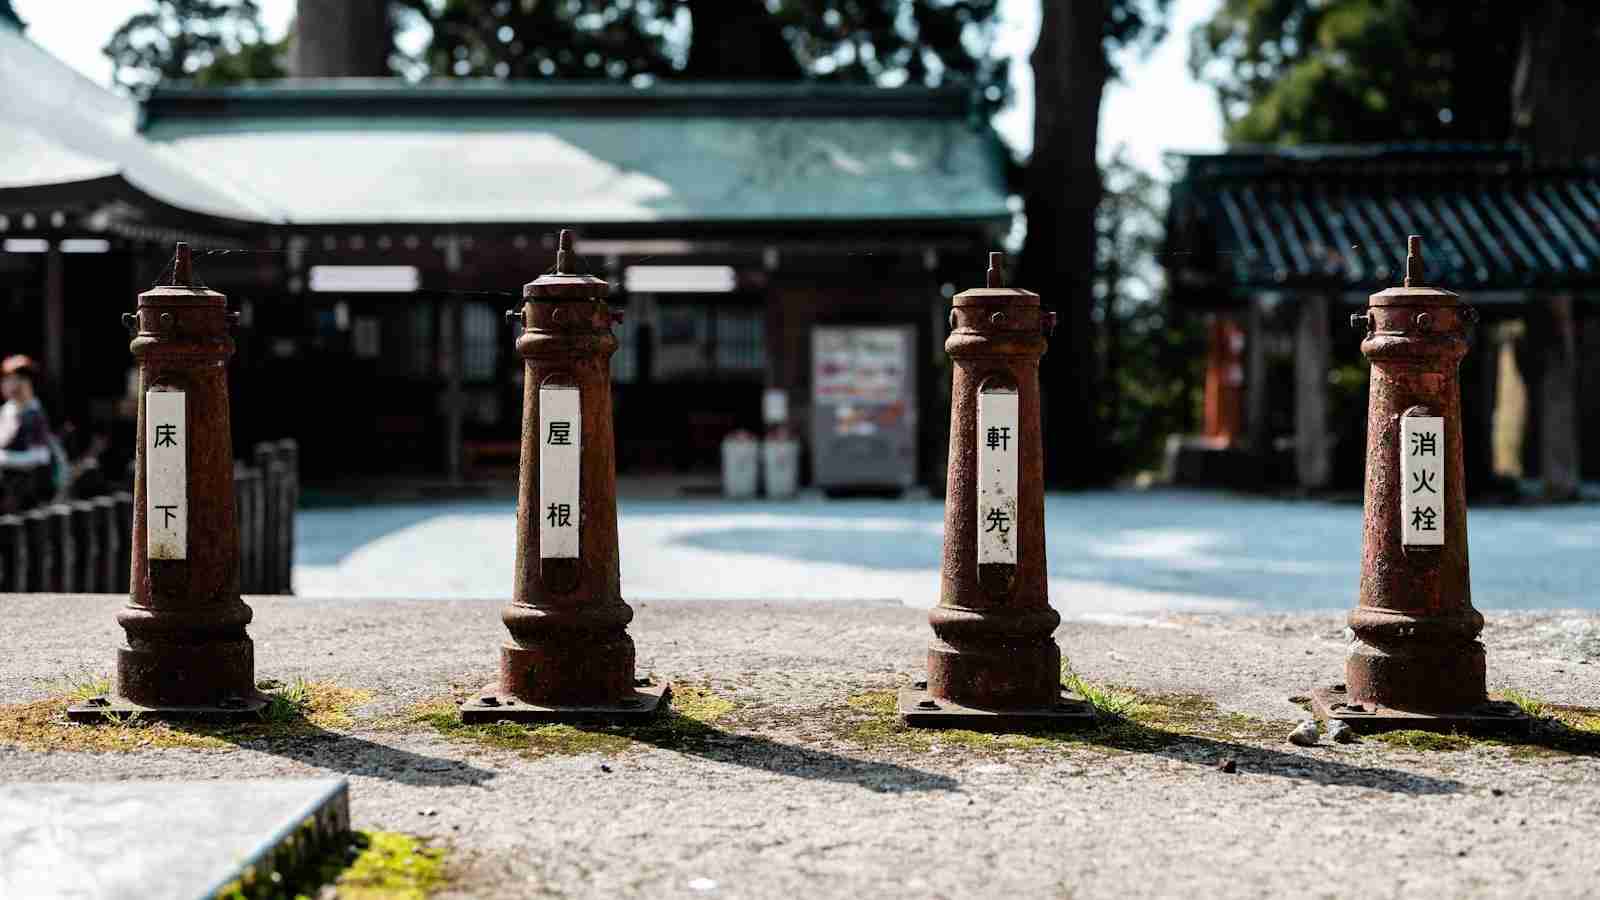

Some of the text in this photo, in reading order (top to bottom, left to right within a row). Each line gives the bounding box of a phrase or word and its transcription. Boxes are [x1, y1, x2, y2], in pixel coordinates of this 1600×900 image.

[154, 423, 178, 529] 床下
[547, 421, 572, 528] 屋根
[986, 426, 1011, 533] 軒先
[1411, 431, 1437, 531] 消火栓
